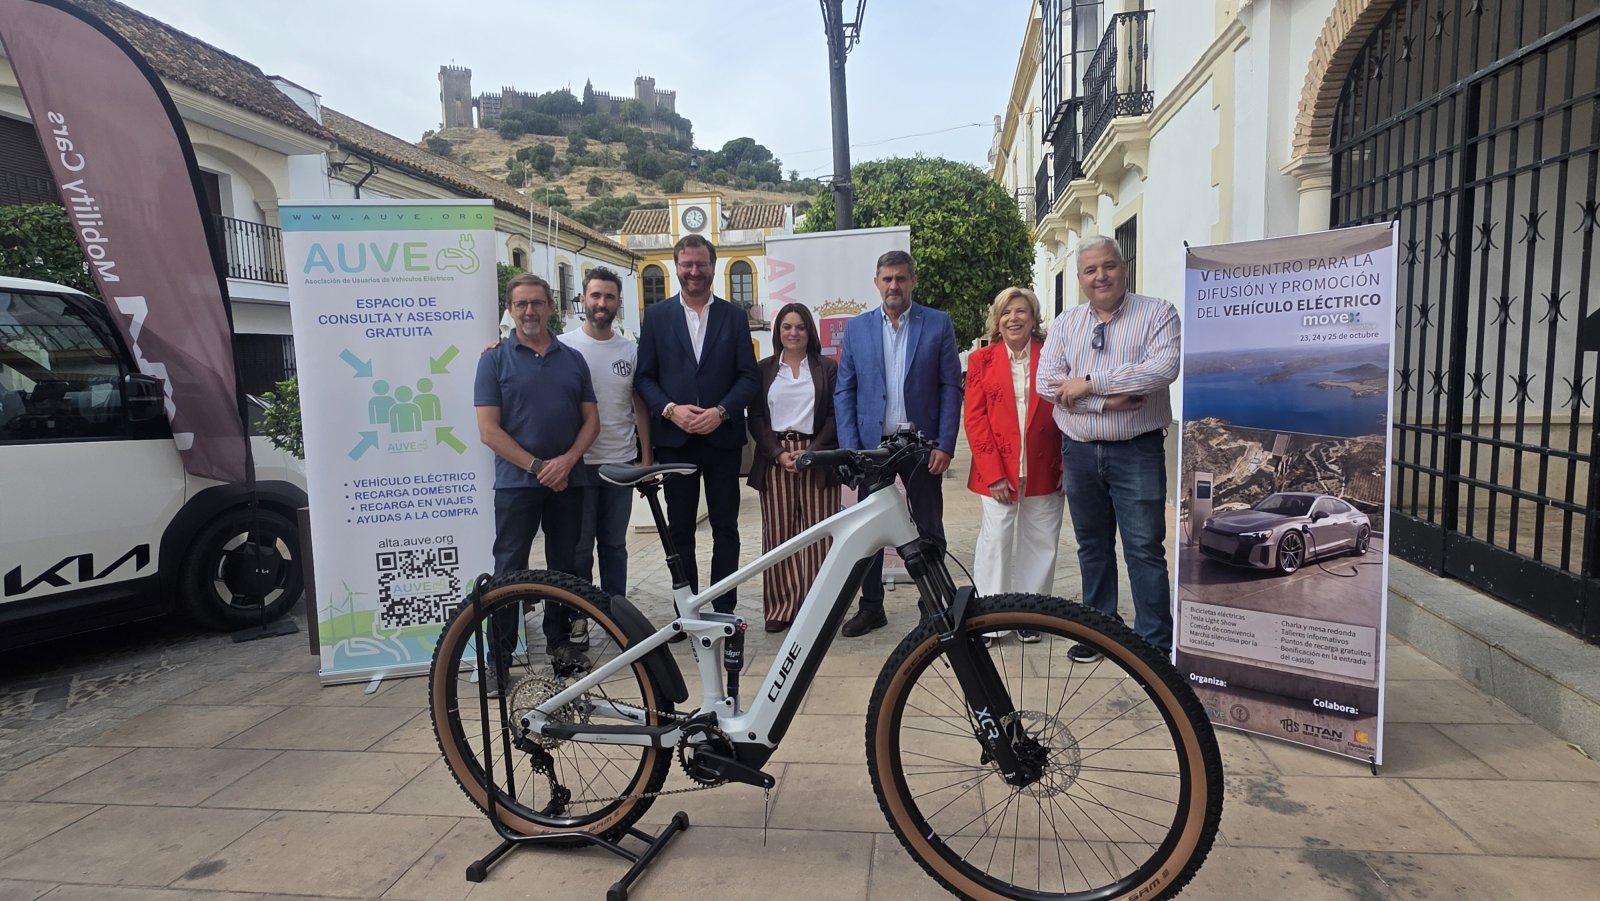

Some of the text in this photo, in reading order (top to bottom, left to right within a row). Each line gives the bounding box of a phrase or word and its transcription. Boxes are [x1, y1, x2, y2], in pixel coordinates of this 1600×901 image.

[303, 242, 430, 274] AUVE
[1201, 253, 1374, 282] V ENCUENTRO PARA LA
[304, 277, 340, 285] Asociación
[351, 276, 380, 284] Usuarios
[1198, 271, 1380, 301] DIFUSIÓN Y PROMOCIÓN
[356, 296, 437, 309] ESPACIO DE
[1197, 293, 1381, 319] DEL VEHÍCULO ELÉCTRICO
[318, 308, 474, 325] CONSULTA Y ASESORÍA
[365, 326, 433, 338] GRATUITA
[1300, 334, 1311, 342] 23,
[1338, 332, 1348, 340] de
[1349, 331, 1380, 339] octubre
[388, 441, 416, 451] AUVE
[353, 471, 476, 488] VEHÍCULO ELÉCTRICO
[355, 483, 477, 500] RECARGA DOMÉSTICA
[360, 495, 474, 512] RECARGA EN VIAJES
[356, 507, 479, 525] AYUDAS A LA COMPRA
[378, 535, 454, 548] alta.auve.org
[393, 581, 432, 593] AUVE
[1190, 606, 1246, 621] Bicicletas eléctricas
[1190, 614, 1237, 627] Tesla Light Show
[1189, 622, 1256, 638] Comida de convivencia
[1189, 630, 1210, 639] Marcha
[1211, 633, 1240, 644] silenciosa
[1281, 620, 1302, 629] Charla
[1327, 628, 1356, 638] redonda
[1281, 628, 1349, 645] Talleres informativos
[1189, 637, 1215, 647] localidad
[1280, 637, 1372, 657] Puntos de recarga gratuitos
[1280, 645, 1320, 657] Bonificación
[1331, 653, 1338, 661] la
[1338, 656, 1367, 666] entrada
[1280, 653, 1315, 665] del castillo
[767, 641, 802, 703] CUBE
[1189, 672, 1227, 687] Organiza:
[1313, 698, 1359, 715] Colabora:
[975, 705, 1000, 740] XCR
[1302, 723, 1343, 739] TITAN
